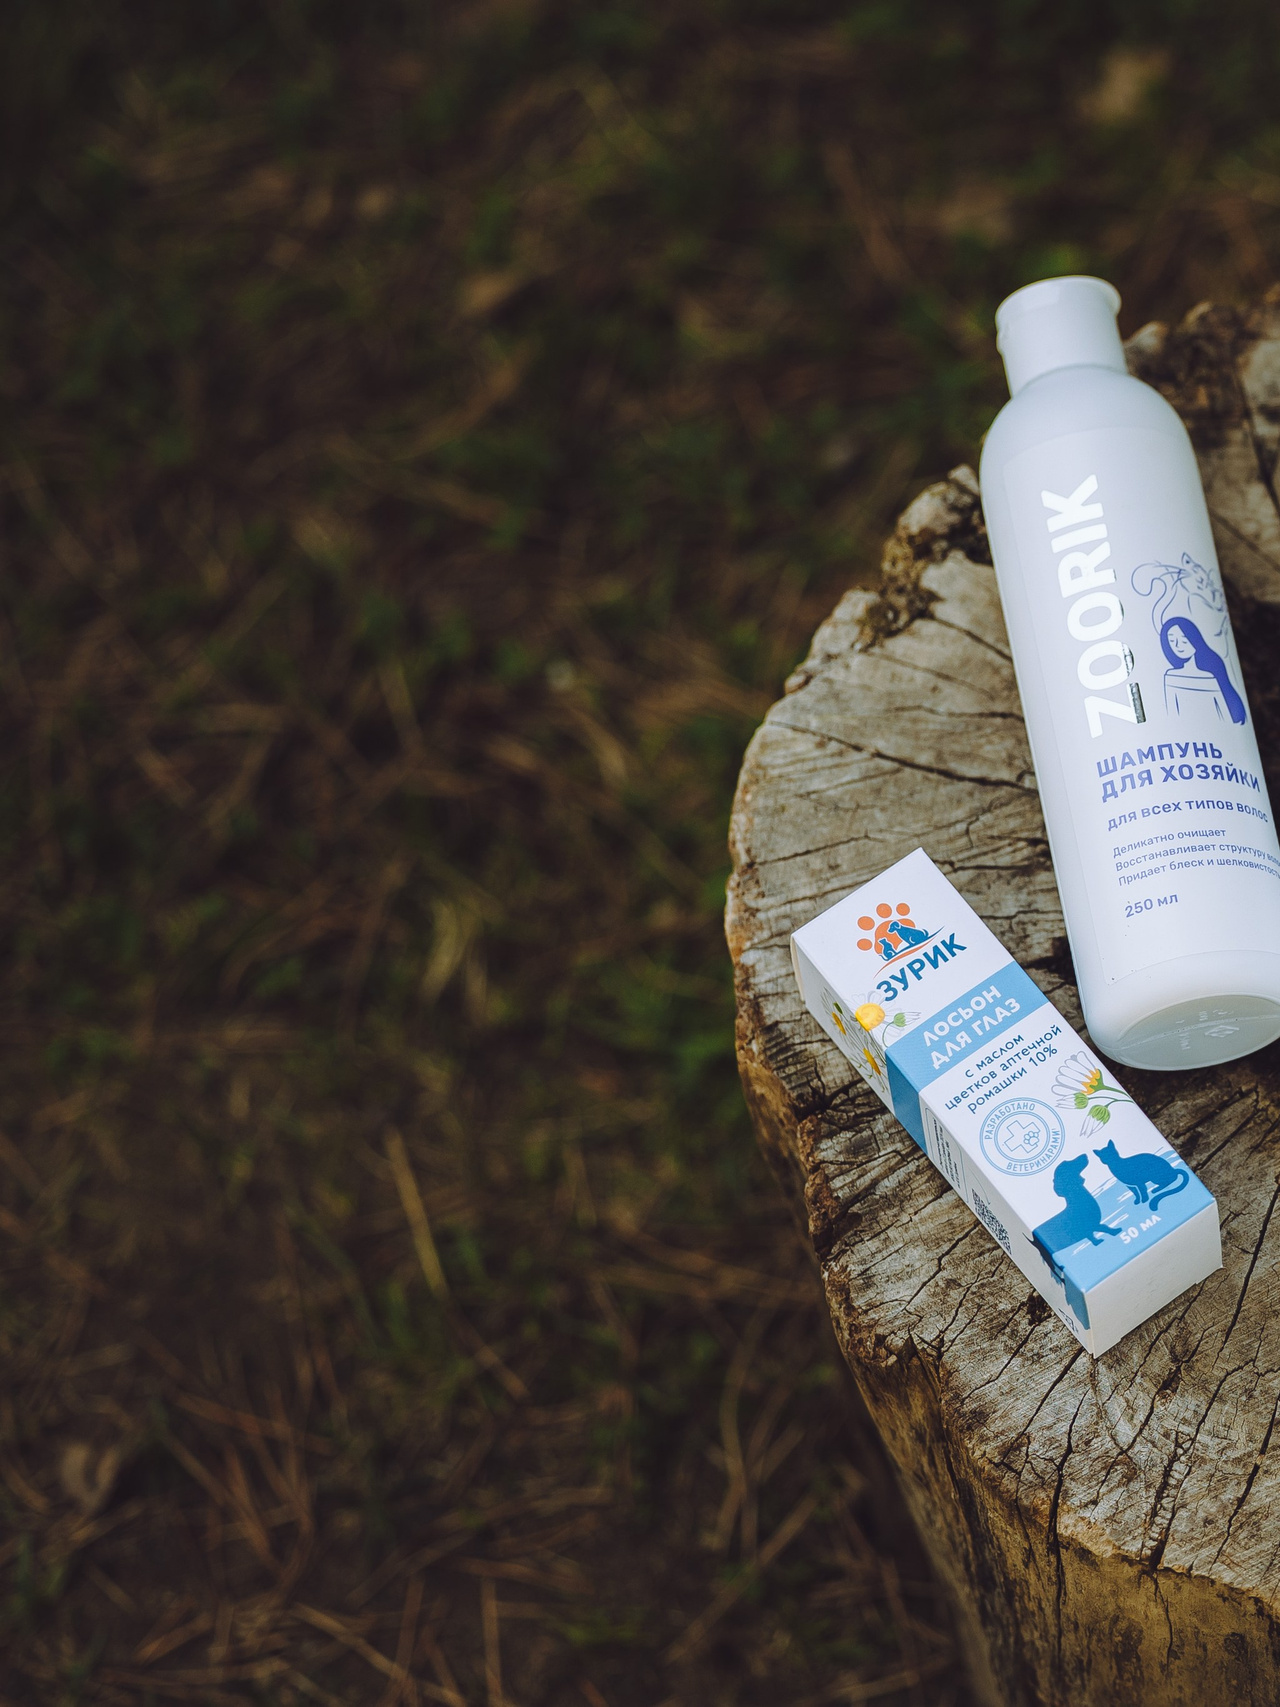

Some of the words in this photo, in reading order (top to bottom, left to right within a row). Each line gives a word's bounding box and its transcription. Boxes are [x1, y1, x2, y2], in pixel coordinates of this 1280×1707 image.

[1041, 474, 1146, 739] ZOORIK
[1096, 742, 1223, 778] ШАМПУНЬ
[1101, 769, 1154, 803] ДЛЯ
[1160, 762, 1261, 793] ХОЗЯЙКИ
[1107, 811, 1137, 831] для
[1141, 801, 1182, 818] всех
[1185, 799, 1234, 811] типов
[1236, 802, 1268, 823] волос
[1113, 833, 1175, 859] Деликатно
[1177, 829, 1226, 839] очищает
[1115, 844, 1216, 872] Восстанавливает
[1219, 844, 1266, 860] структуру
[1118, 865, 1167, 886] Придает
[1169, 859, 1205, 871] блеск
[1206, 858, 1214, 866] и
[1124, 898, 1154, 918] 250
[1157, 894, 1179, 907] мл
[876, 932, 967, 1002] ЗУРИК
[923, 985, 1002, 1047] ЛОСЬОН
[930, 1031, 972, 1070] ДЛЯ
[971, 998, 1020, 1036] ГЛАЗ
[945, 1070, 997, 1110] цветков
[1000, 1024, 1062, 1072] аптечной
[965, 1069, 974, 1078] с
[975, 1034, 1024, 1071] маслом
[967, 1067, 1028, 1114] ромашки
[1029, 1044, 1058, 1067] 10%
[984, 1102, 1036, 1140] РАЗРАБОТАНО
[1120, 1227, 1139, 1244] 50
